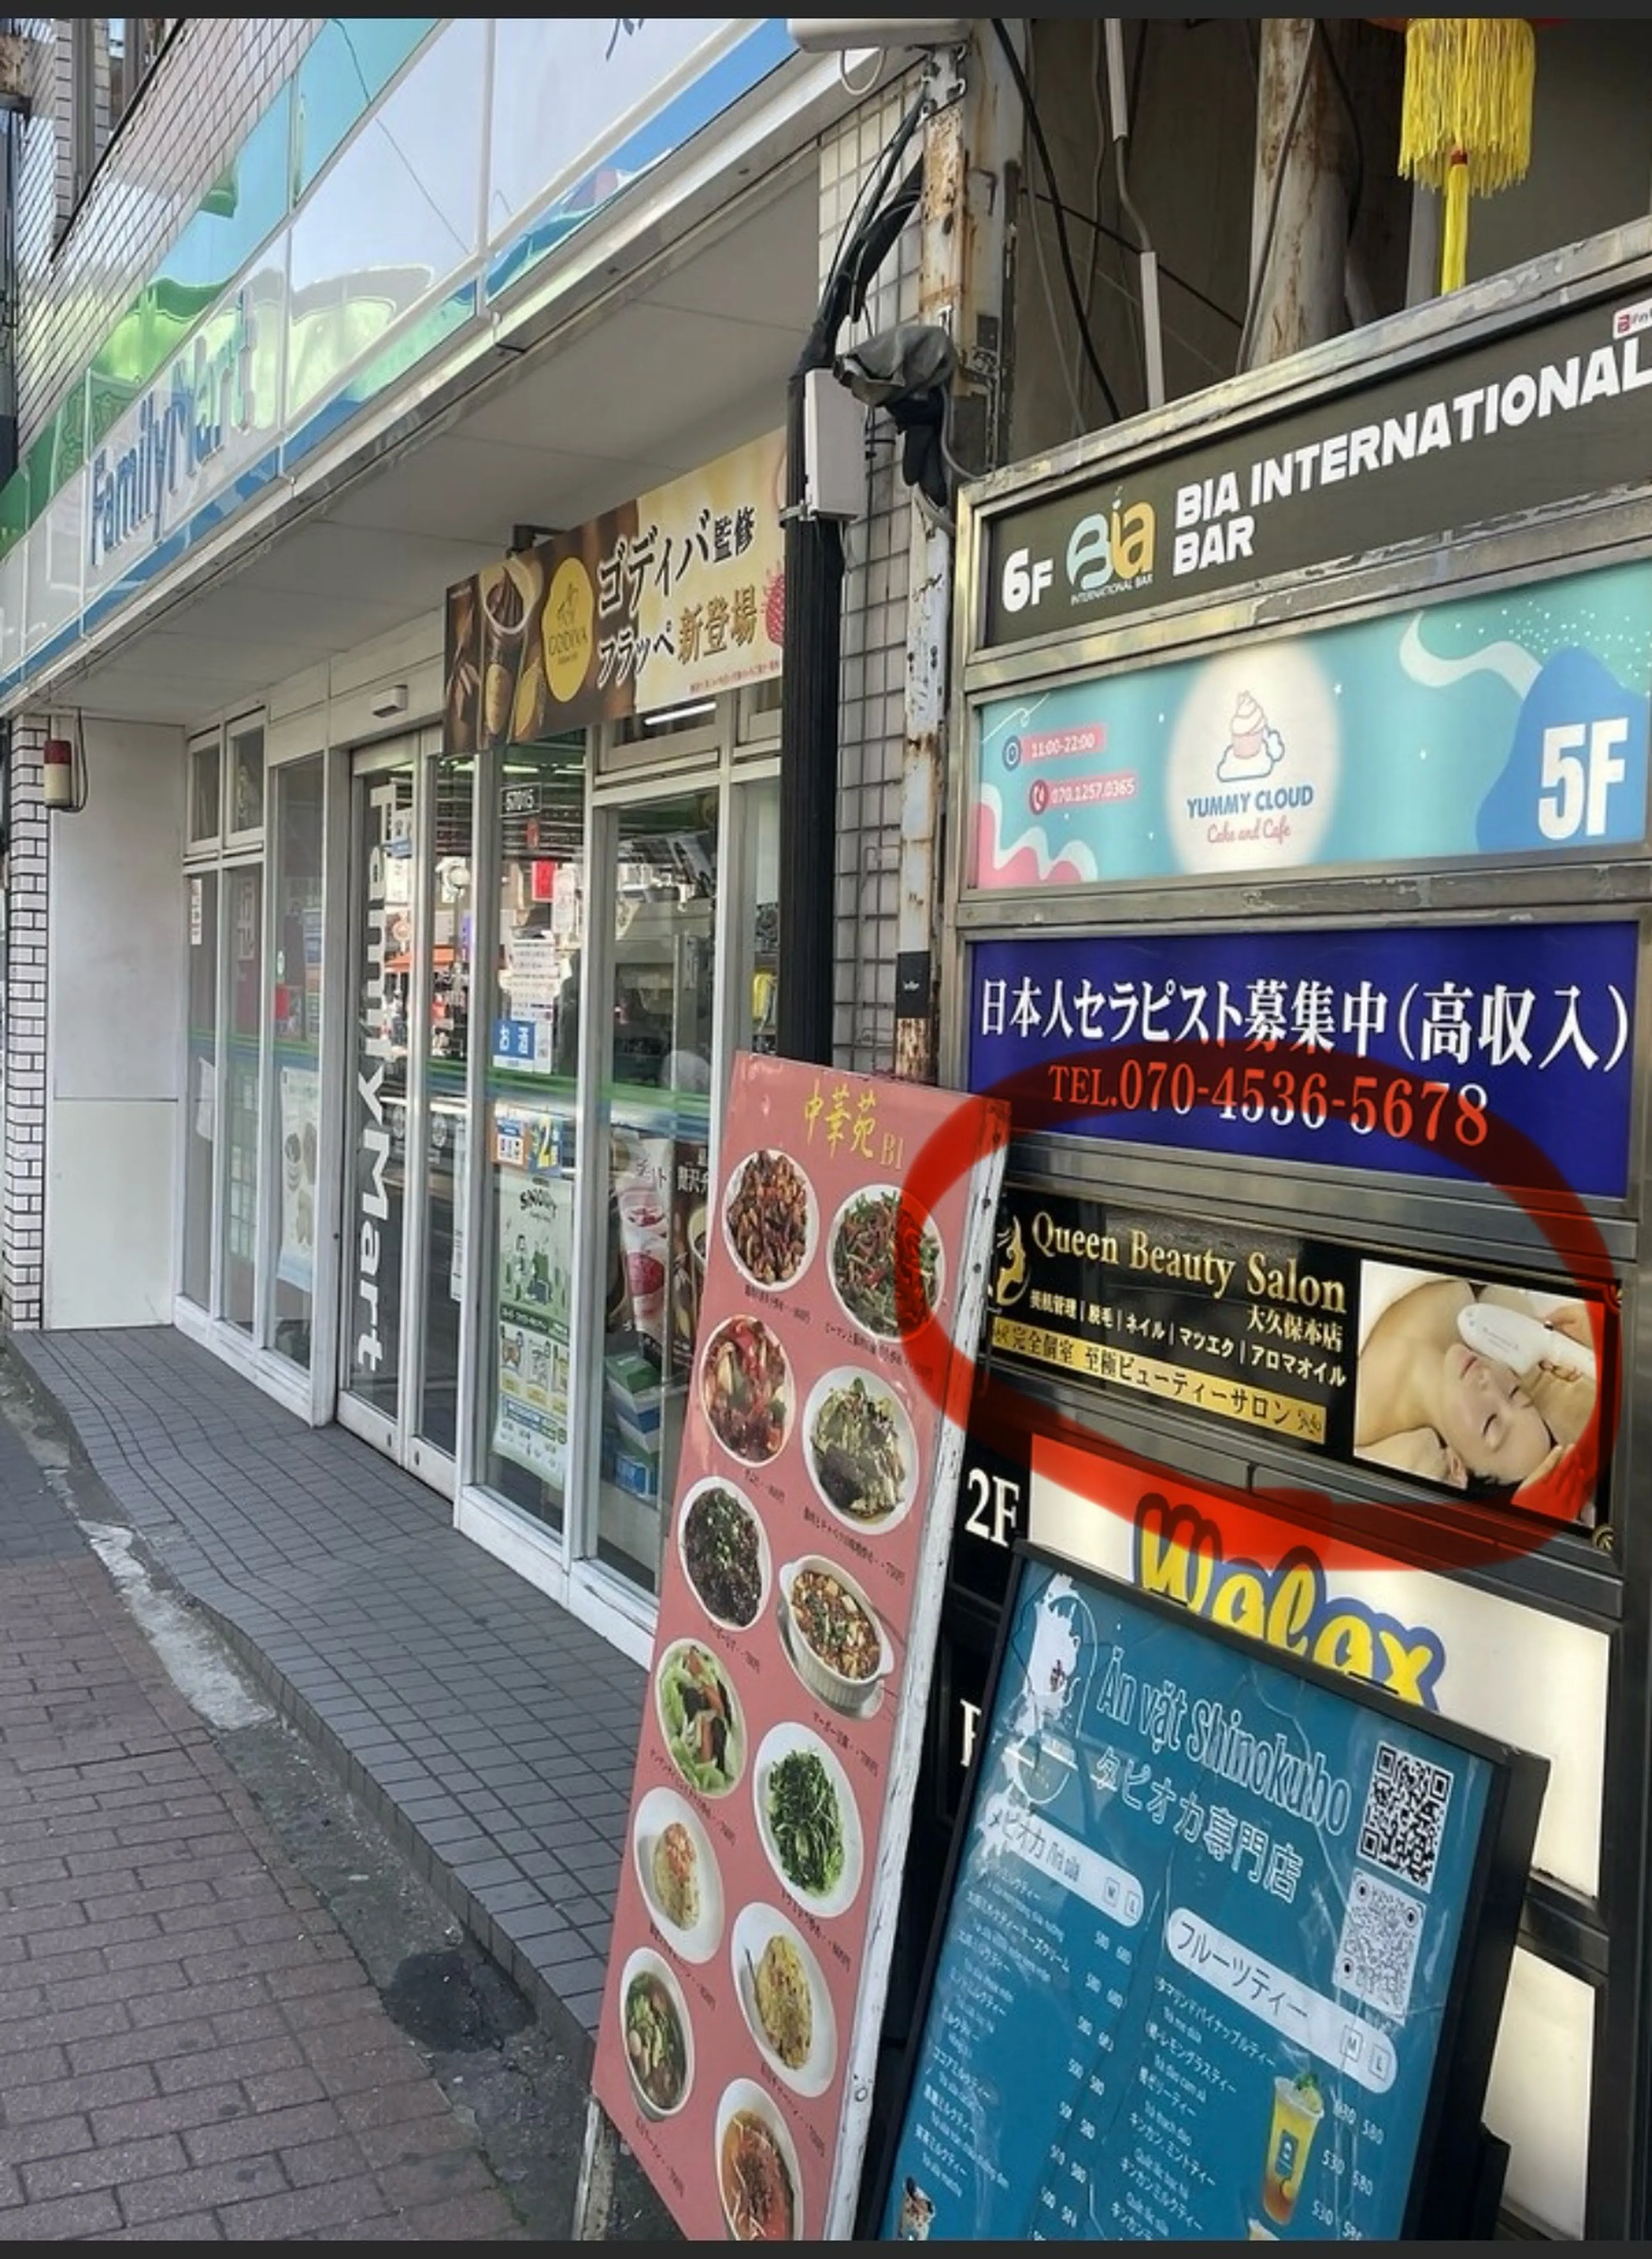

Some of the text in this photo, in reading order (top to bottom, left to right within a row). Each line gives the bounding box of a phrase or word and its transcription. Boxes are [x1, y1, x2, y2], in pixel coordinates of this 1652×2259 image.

[91, 287, 255, 567] FamilyMart
[1175, 336, 1652, 529] BIA INTERNATIONAL
[597, 505, 756, 618] ゴディバ監修
[1002, 547, 1053, 612] 6F
[1173, 515, 1255, 576] BAR
[1070, 573, 1153, 606] INTERNATIONAL BAR
[598, 583, 759, 688] フラッペ新登場
[1031, 732, 1095, 759] 11:00-22:00
[1538, 717, 1629, 840] 5F
[1187, 785, 1314, 820] YUMMY CLOUD
[1207, 815, 1290, 845] Cake and Cafe
[981, 976, 1628, 1072] 日本人セラピスト募集中(高収入)
[1048, 1059, 1488, 1146] TEL.070-4536-5678
[1032, 1211, 1347, 1314] Queen Beauty Salon
[1126, 1312, 1165, 1339] ネイル
[1179, 1327, 1234, 1357] マツエク
[1251, 1344, 1347, 1387] アロマオイル
[1247, 1304, 1343, 1352] 大久保本店
[964, 1466, 1021, 1546] 2F
[1186, 1699, 1351, 1838] Shinokubo
[1178, 1921, 1308, 2017] フルーツティー
